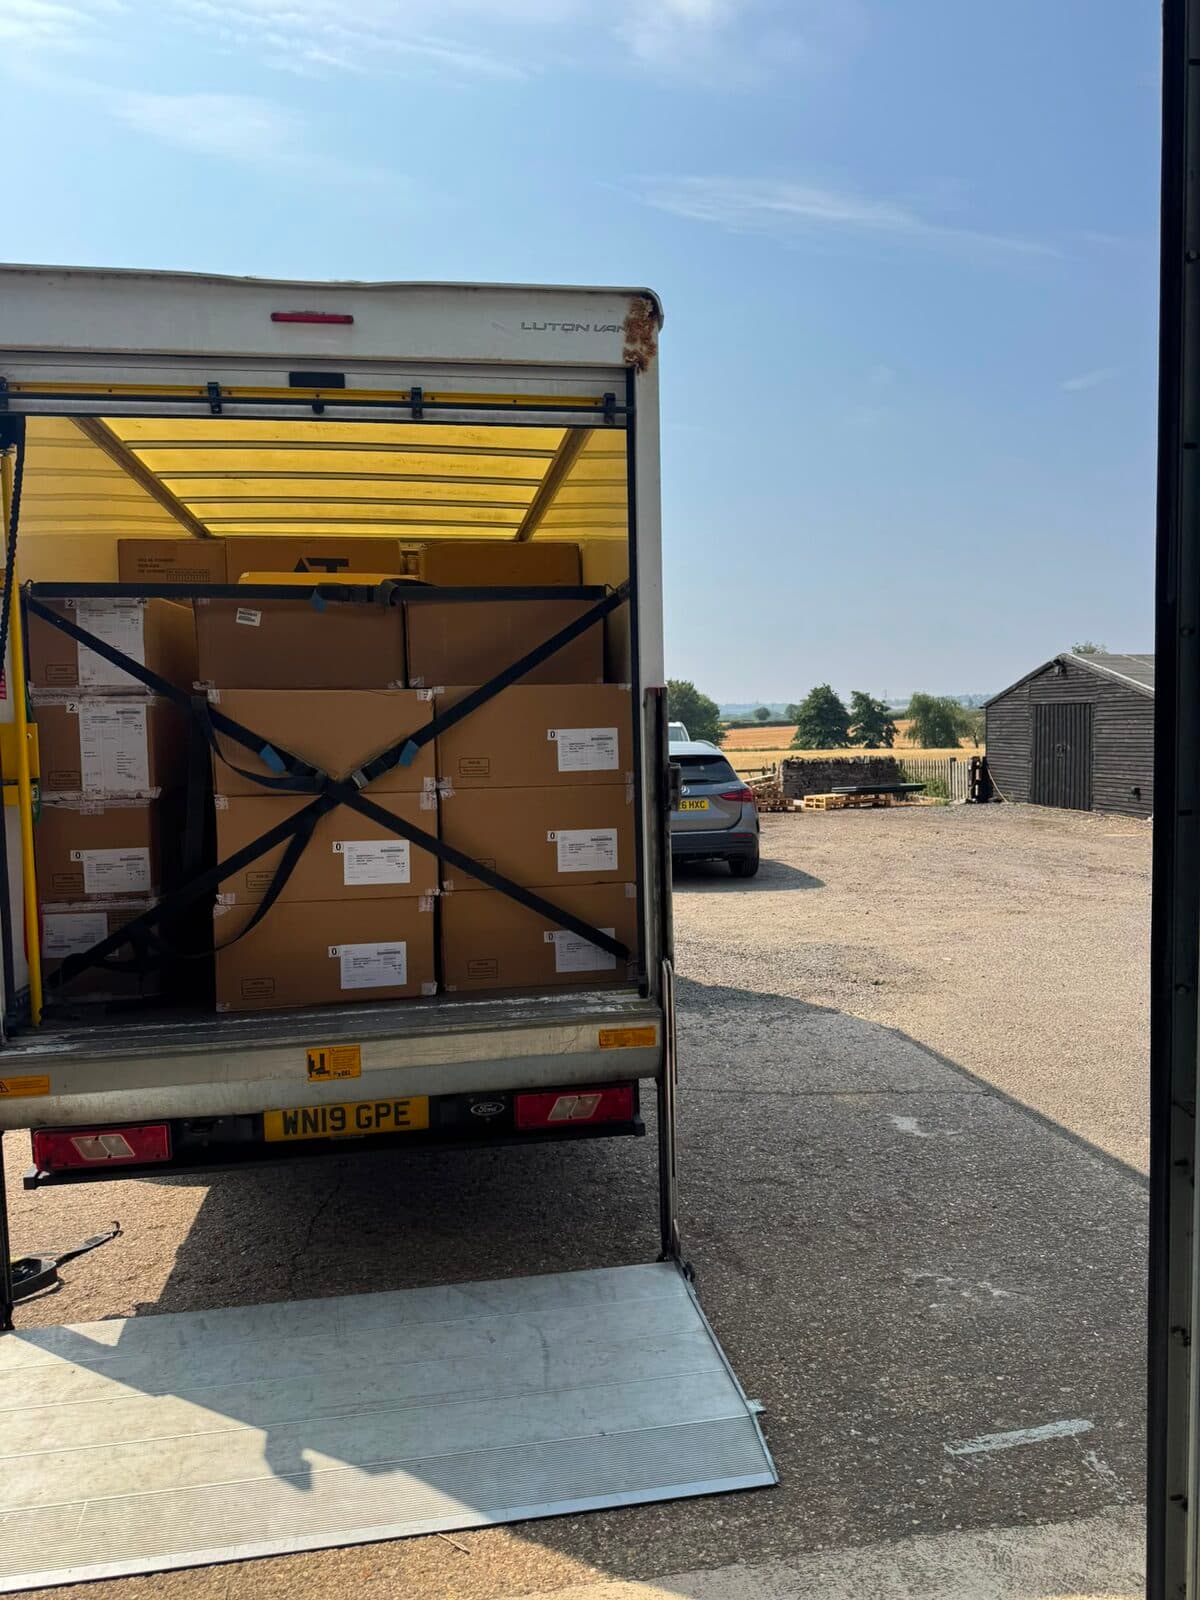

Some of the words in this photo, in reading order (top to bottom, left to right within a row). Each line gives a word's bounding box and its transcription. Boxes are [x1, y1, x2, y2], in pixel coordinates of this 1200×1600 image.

[521, 322, 590, 332] LUTON
[69, 703, 75, 711] 2
[550, 730, 556, 739] 0
[688, 800, 705, 809] HXC
[335, 842, 342, 851] 0
[75, 851, 81, 859] 0
[331, 947, 338, 956] 0
[282, 1106, 346, 1136] WN19
[355, 1100, 411, 1129] GPE
